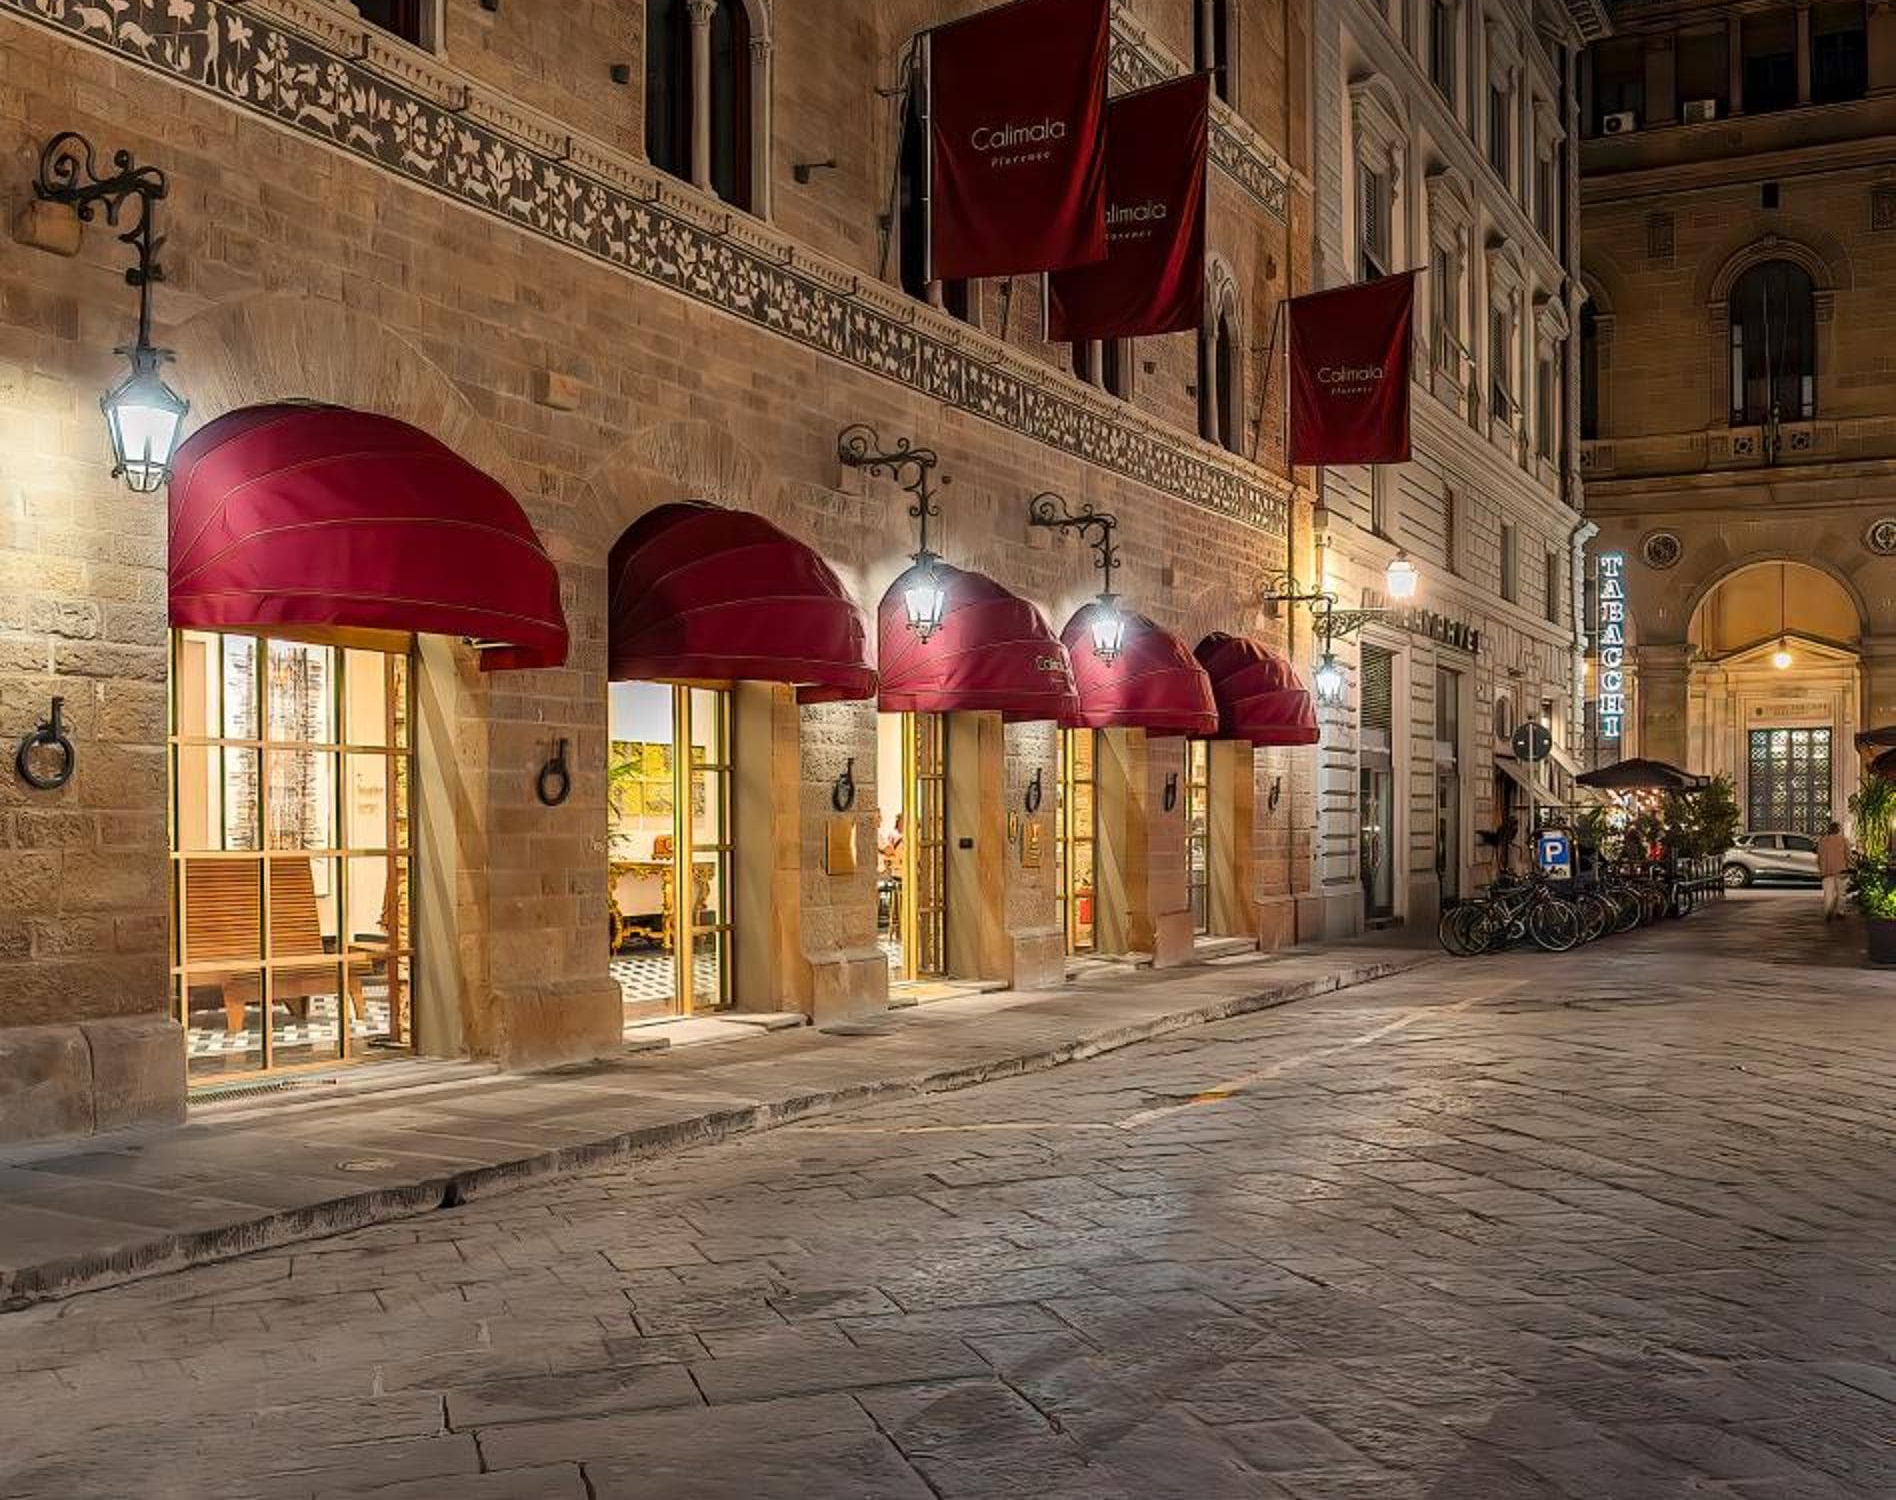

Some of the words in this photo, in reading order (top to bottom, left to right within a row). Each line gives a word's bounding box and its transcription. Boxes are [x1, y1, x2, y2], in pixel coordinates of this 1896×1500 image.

[971, 116, 1065, 151] Calimala
[1105, 199, 1167, 224] limala
[1317, 364, 1384, 383] Calimala
[1600, 556, 1624, 737] TABACCHI
[1545, 841, 1563, 863] P
